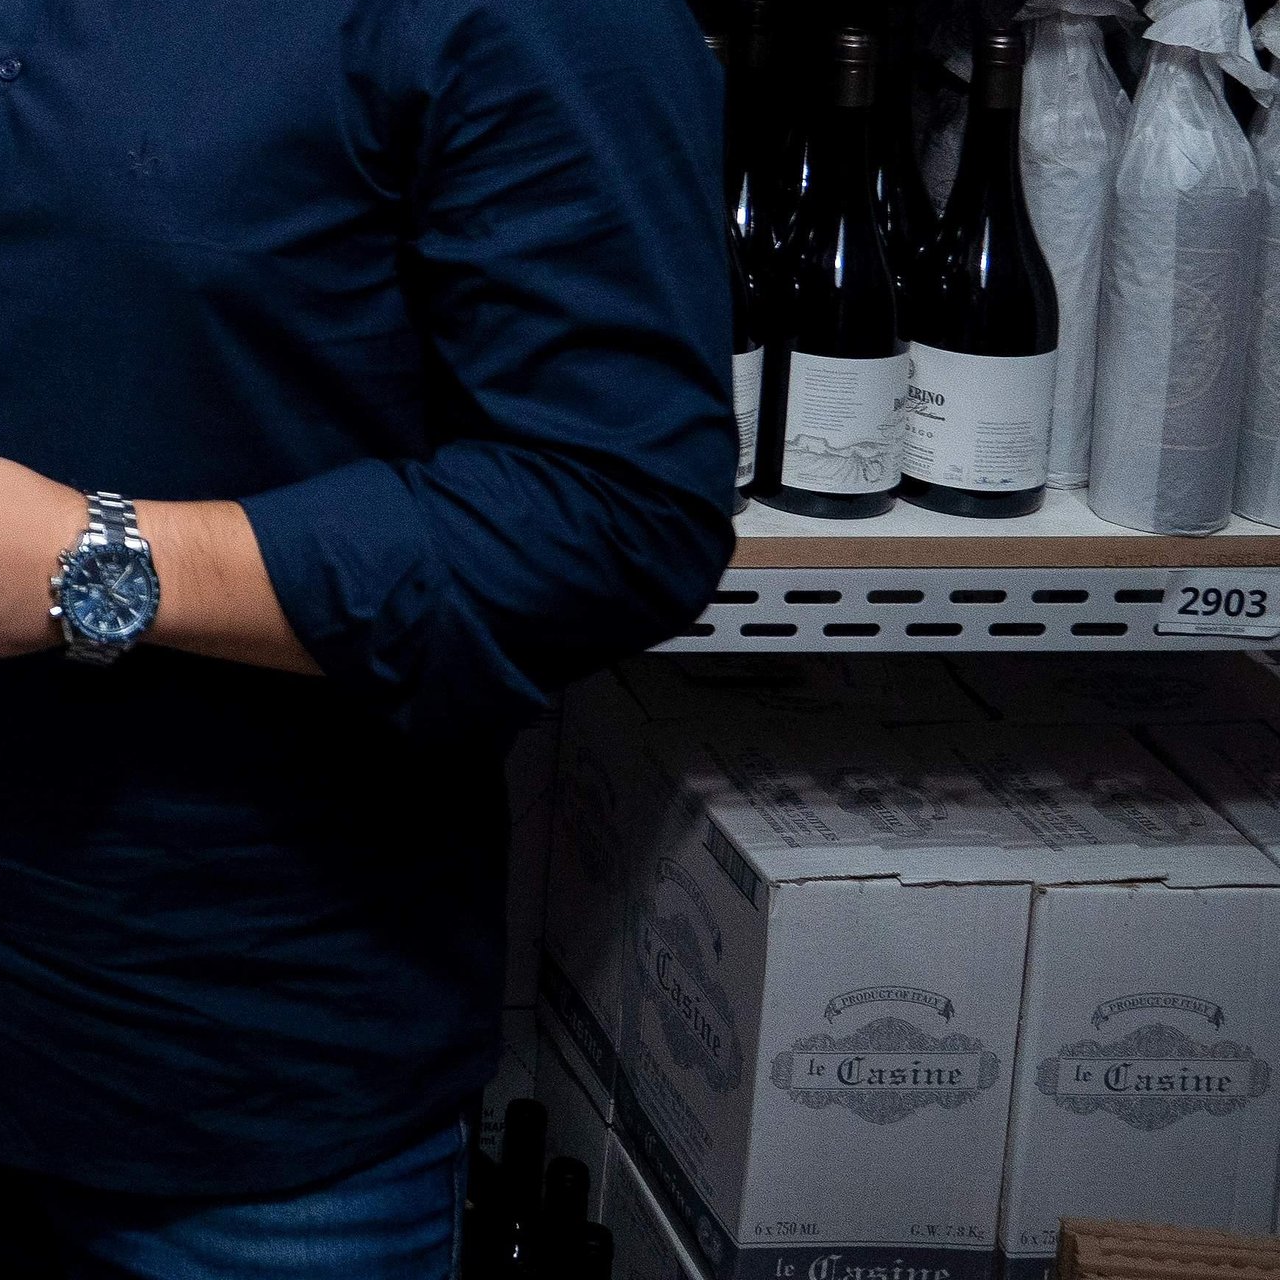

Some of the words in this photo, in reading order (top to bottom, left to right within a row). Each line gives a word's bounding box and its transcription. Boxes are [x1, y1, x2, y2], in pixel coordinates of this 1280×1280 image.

[1177, 586, 1268, 618] 2903
[841, 988, 892, 1008] PRODUCT
[894, 988, 910, 1001] OF
[911, 991, 941, 1009] ITALY
[1108, 996, 1159, 1014] PRODUCT
[1161, 996, 1177, 1007] OF
[1178, 998, 1210, 1015] ITALY
[807, 1058, 826, 1078] le
[836, 1056, 963, 1086] Casine
[1074, 1064, 1093, 1083] le
[1103, 1062, 1233, 1094] Casine
[754, 1221, 763, 1236] 6
[776, 1221, 797, 1236] 750
[799, 1222, 821, 1236] ML
[775, 1257, 795, 1278] le
